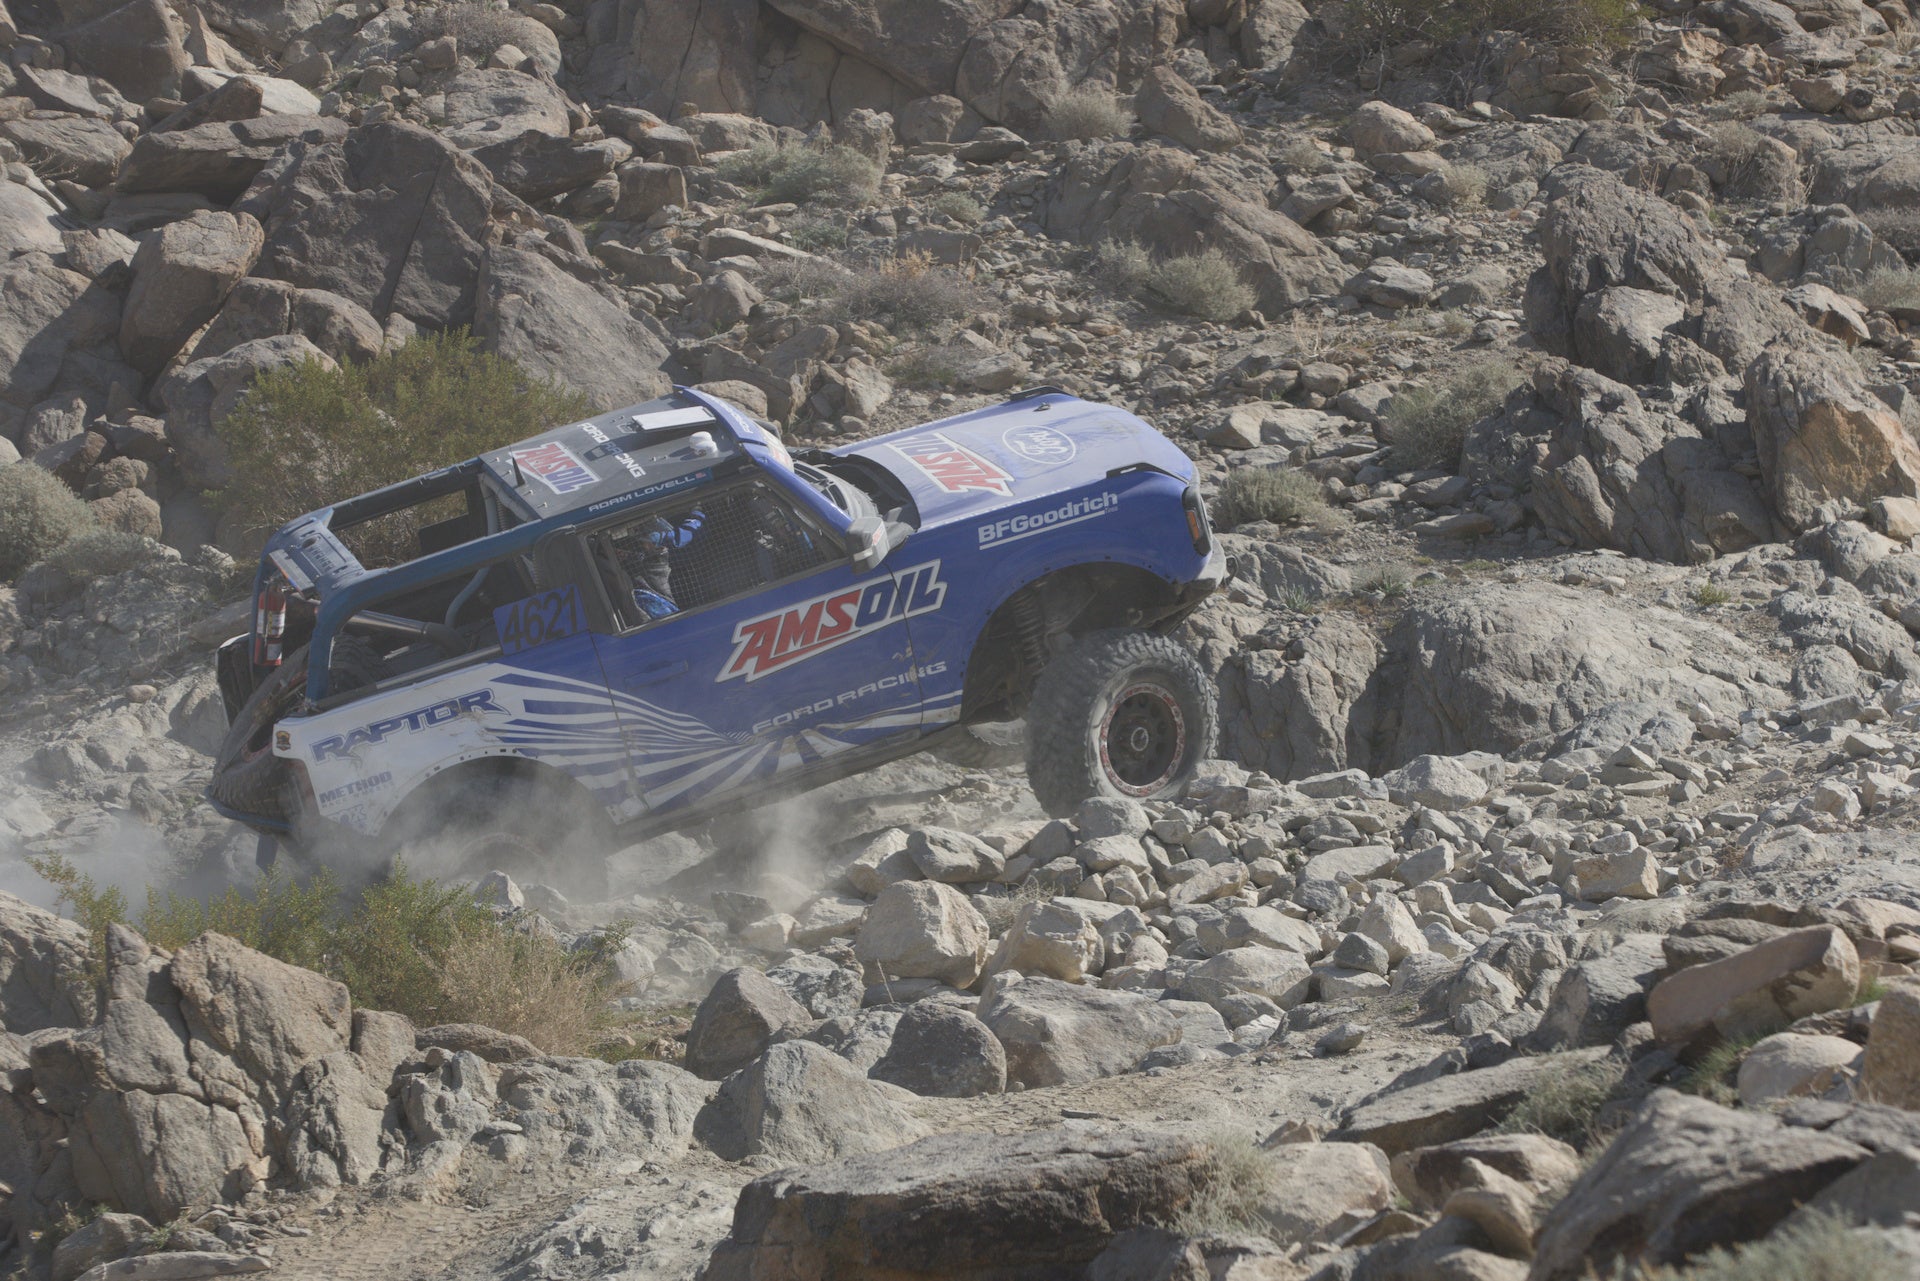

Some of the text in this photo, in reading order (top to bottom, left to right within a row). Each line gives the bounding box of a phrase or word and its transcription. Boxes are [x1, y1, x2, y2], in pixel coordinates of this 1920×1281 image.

[508, 442, 597, 493] AMSOIL
[577, 422, 646, 478] FORD RACING
[888, 433, 1012, 494] AMSOIL
[1016, 430, 1069, 456] Ford
[588, 475, 696, 513] ADAM LOVELL
[978, 491, 1119, 544] BFGoodrich
[502, 585, 579, 651] 4621
[724, 562, 945, 678] AMSOIL
[752, 660, 948, 735] FORD RACING
[311, 688, 511, 767] RAPTOR
[318, 770, 393, 804] METHOD
